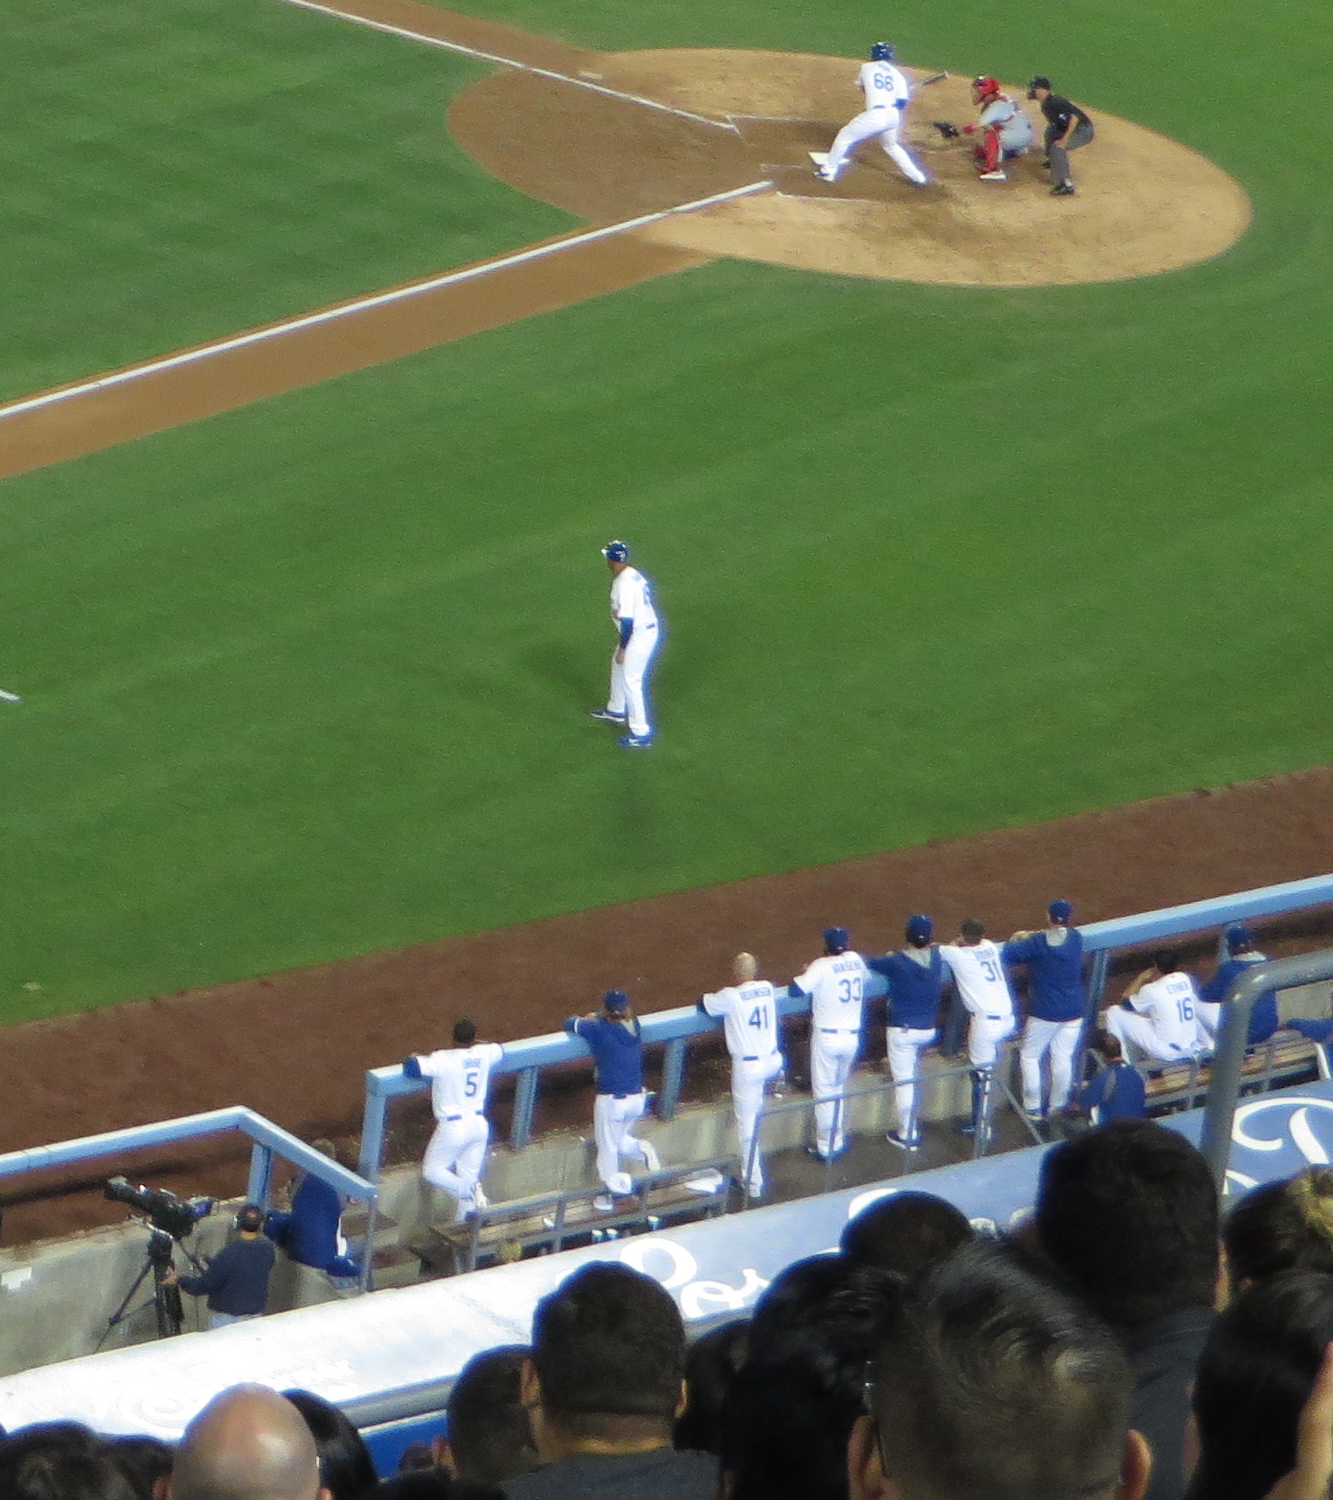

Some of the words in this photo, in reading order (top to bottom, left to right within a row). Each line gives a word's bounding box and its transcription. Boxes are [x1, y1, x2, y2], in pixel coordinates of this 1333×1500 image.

[873, 72, 895, 92] 66
[979, 960, 1003, 983] 31
[838, 976, 861, 1004] 33
[747, 1004, 769, 1030] 41
[1175, 996, 1194, 1024] 16
[464, 1071, 478, 1098] 5
